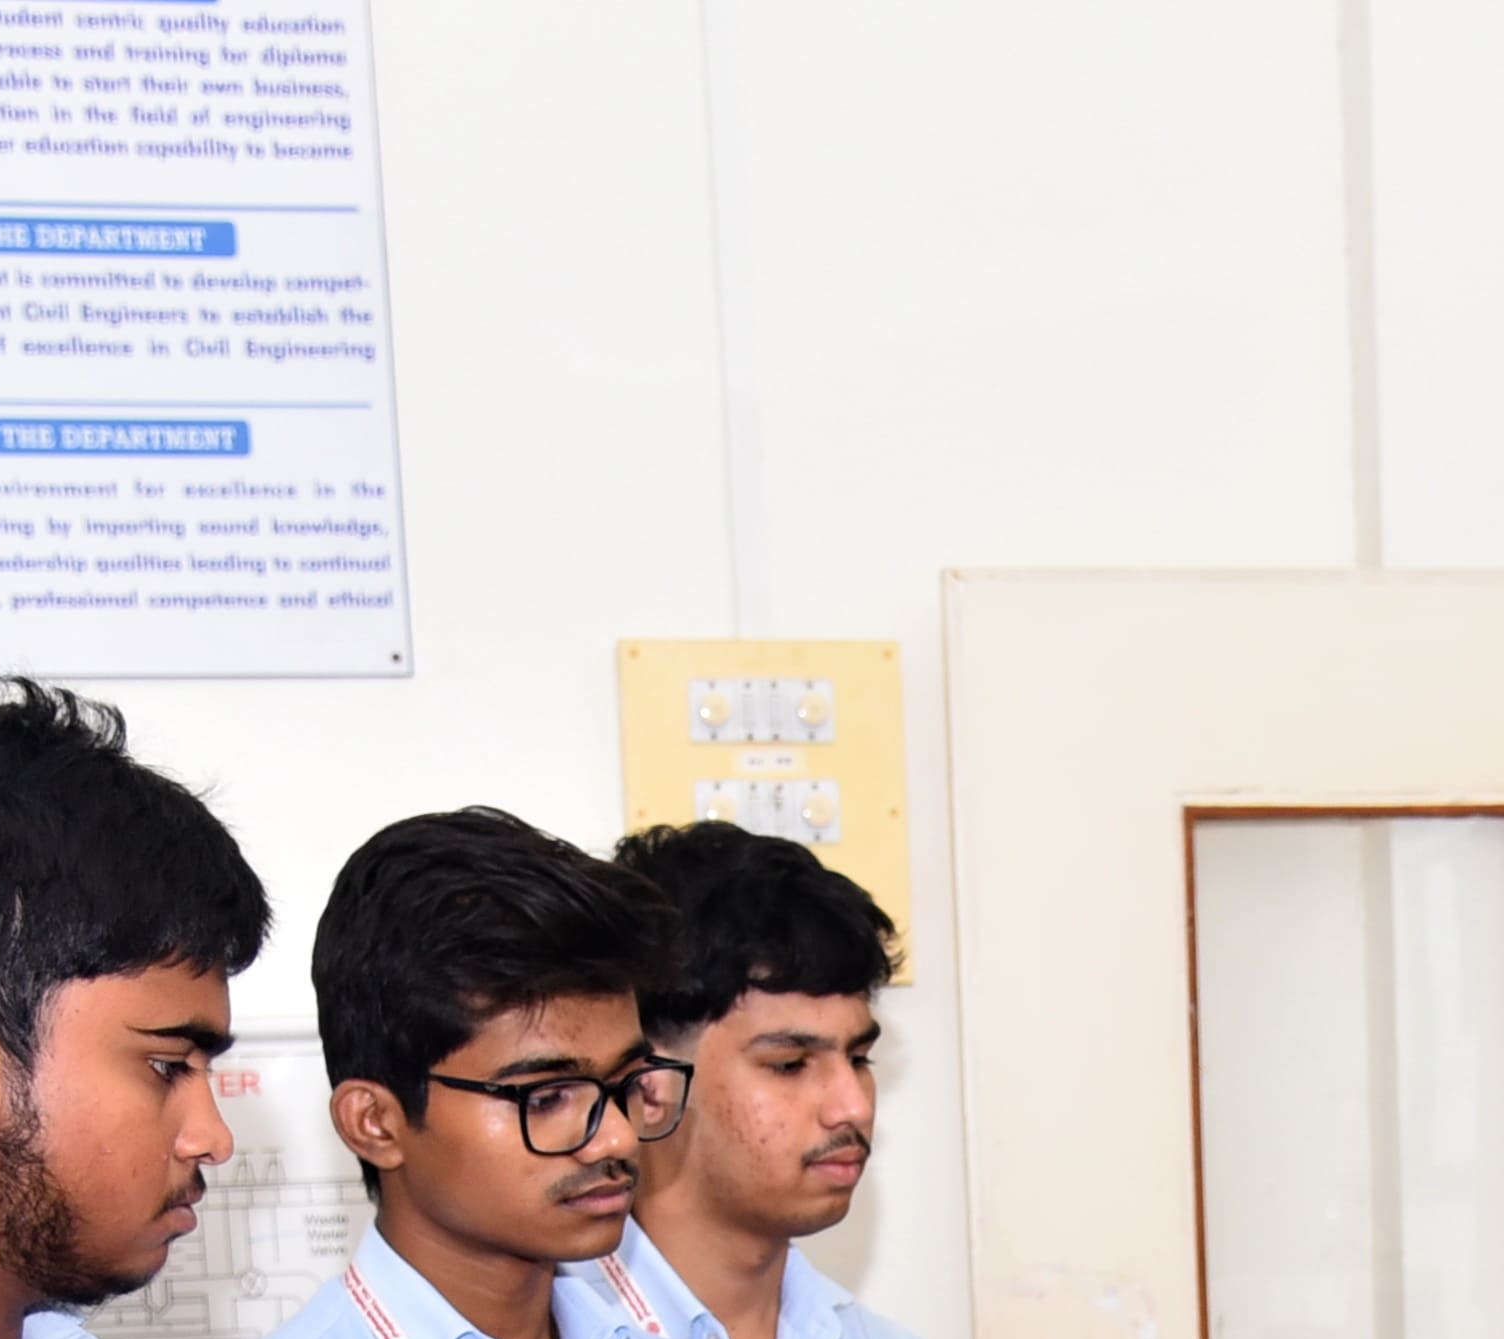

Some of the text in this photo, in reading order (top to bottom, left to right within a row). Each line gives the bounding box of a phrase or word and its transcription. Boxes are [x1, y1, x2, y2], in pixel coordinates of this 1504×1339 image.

[35, 223, 207, 252] DEPARTMENT
[0, 424, 55, 449] THE
[61, 425, 236, 450] DEPARTMENT
